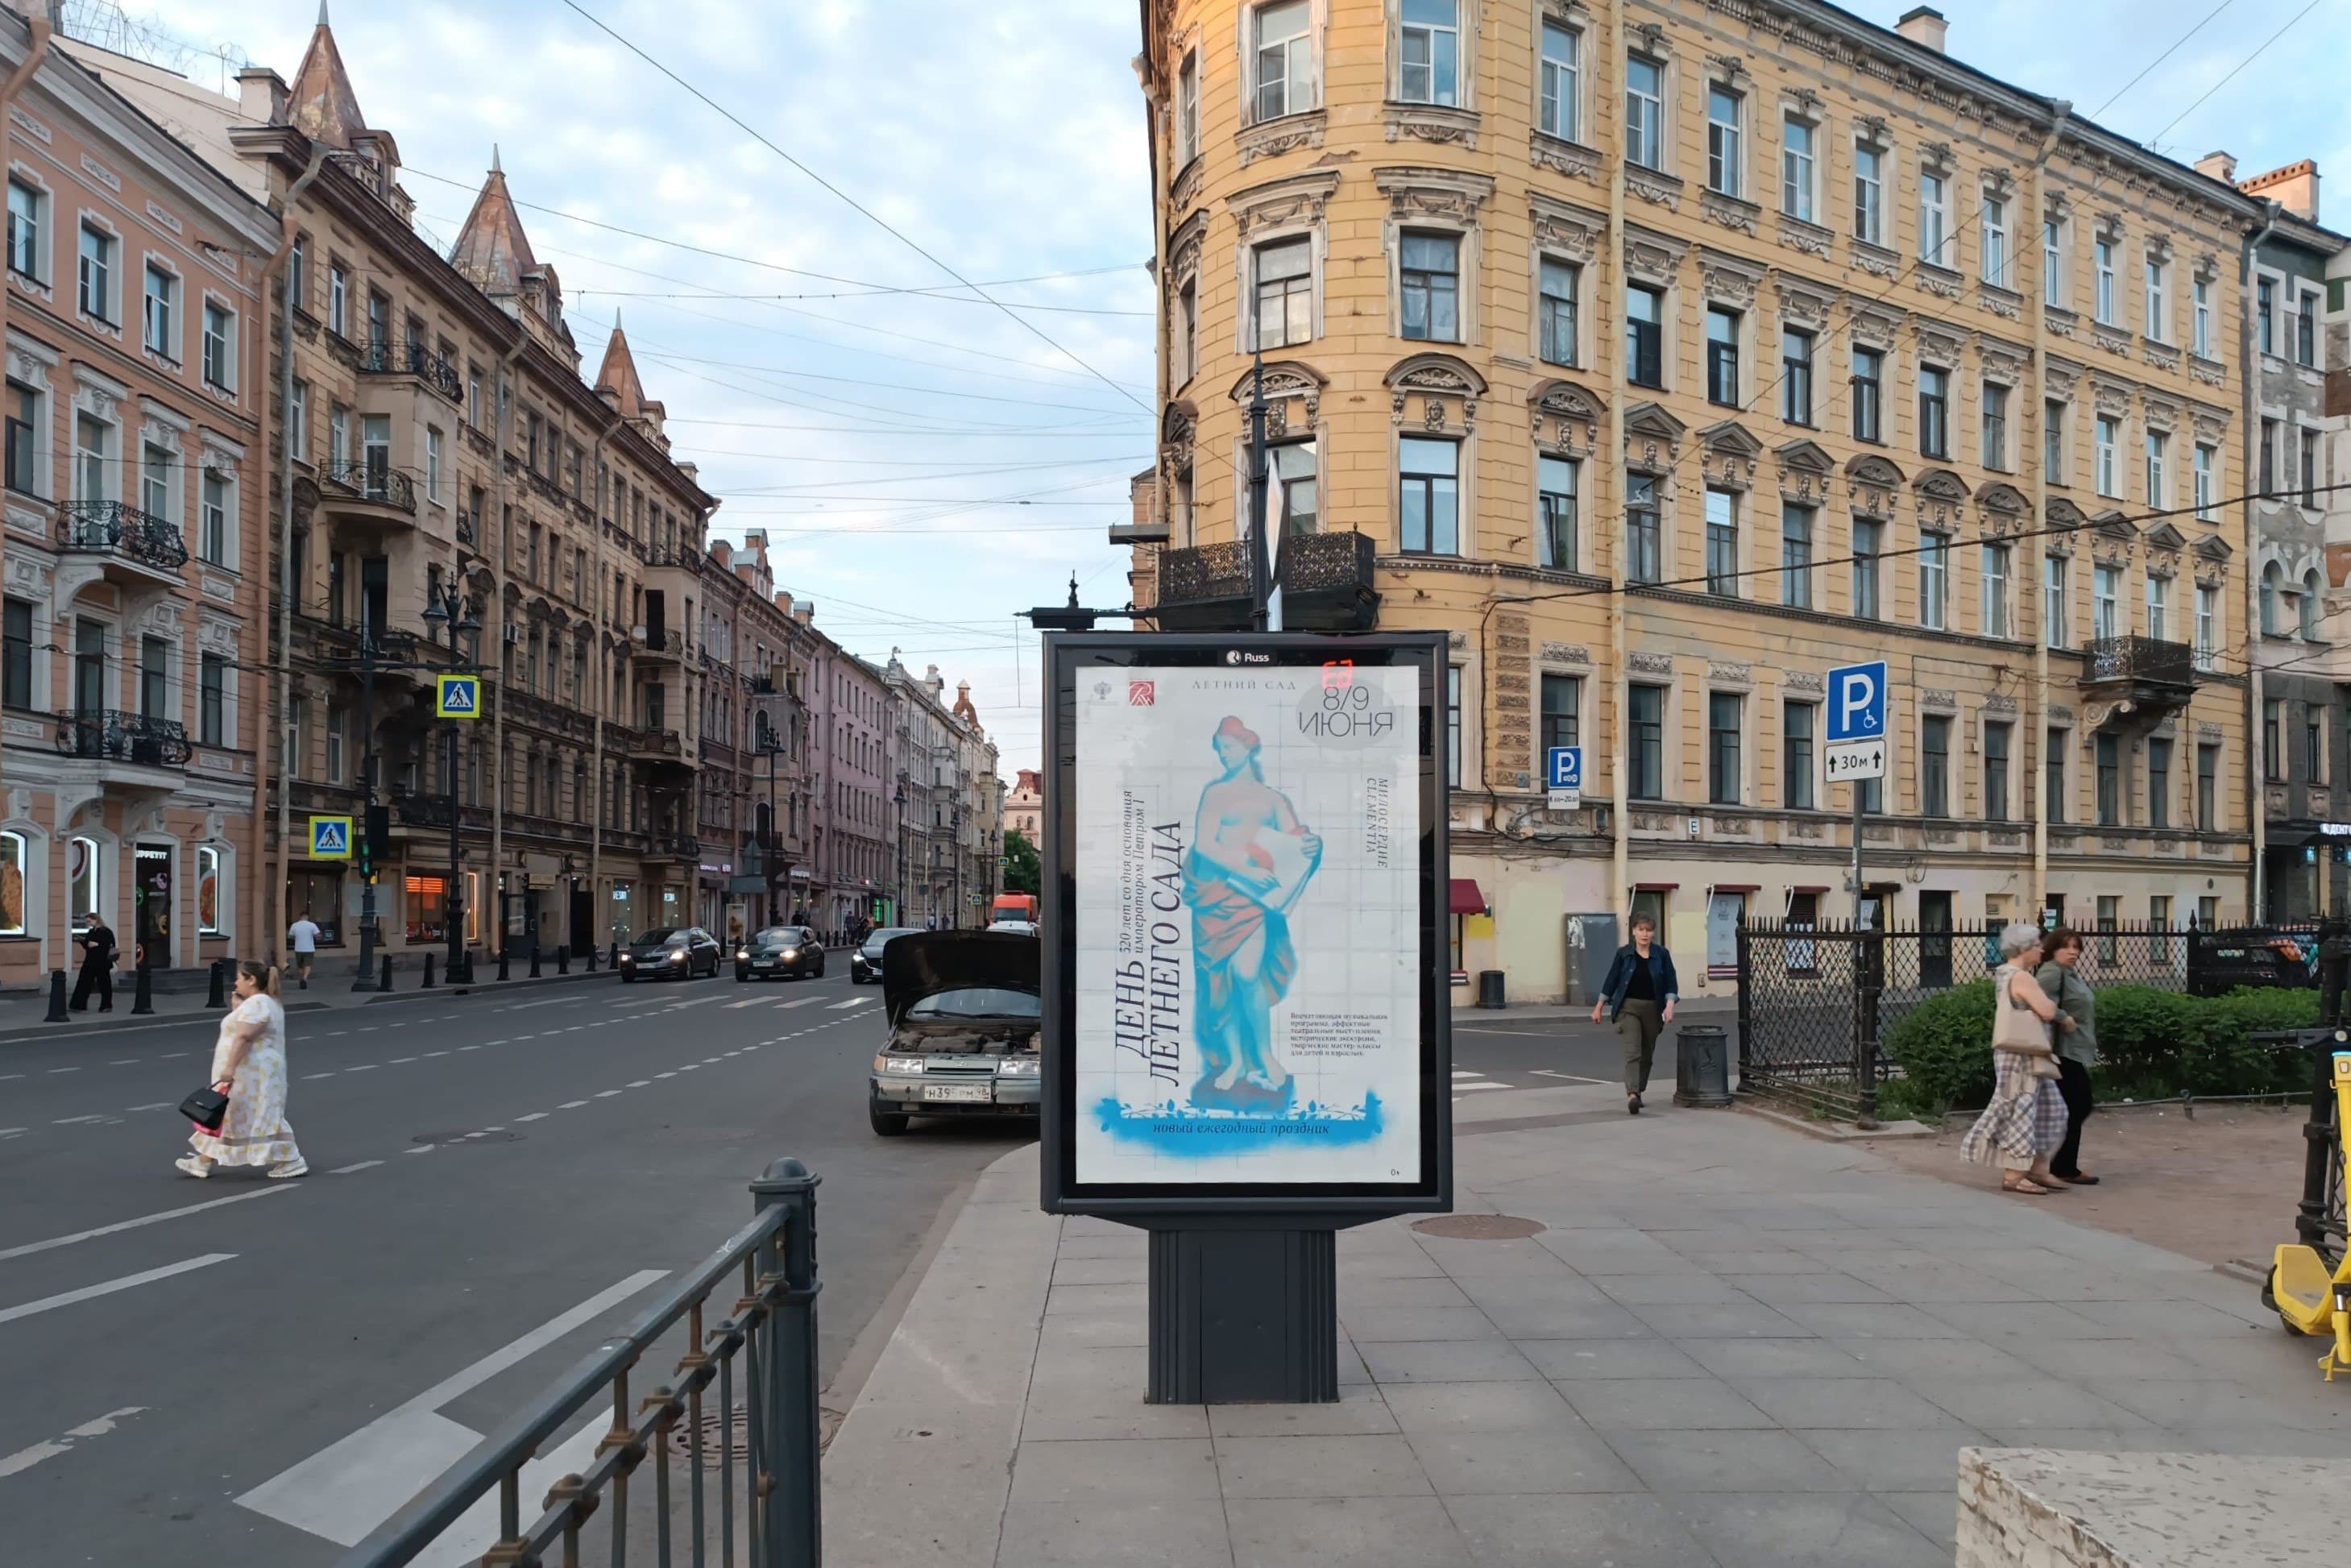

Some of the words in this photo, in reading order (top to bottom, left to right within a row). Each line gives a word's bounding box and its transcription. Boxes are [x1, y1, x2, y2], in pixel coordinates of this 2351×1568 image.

[1245, 653, 1270, 662] Russ
[1192, 678, 1256, 690] ЛЕТНИЙ
[1264, 681, 1296, 691] САД
[1323, 685, 1369, 711] 8/9
[1842, 674, 1874, 732] P
[1300, 711, 1392, 737] ИЮНЯ
[1557, 752, 1575, 783] P
[1123, 790, 1133, 857] основания
[1133, 809, 1146, 859] Петром
[1366, 778, 1377, 852] CLEMENTIA
[1377, 778, 1388, 868] МИЛОСЕРДИЕ
[1121, 861, 1132, 882] дня
[1151, 820, 1185, 912] САДА
[1122, 887, 1131, 900] со
[1135, 865, 1146, 953] императором
[1122, 905, 1131, 930] лет
[1115, 960, 1151, 1060] ДЕНЬ
[1151, 922, 1180, 1087] ЛЕТНЕГО
[1154, 1122, 1192, 1134] новый
[1197, 1122, 1266, 1134] ежегодный
[1271, 1122, 1329, 1137] праздник
